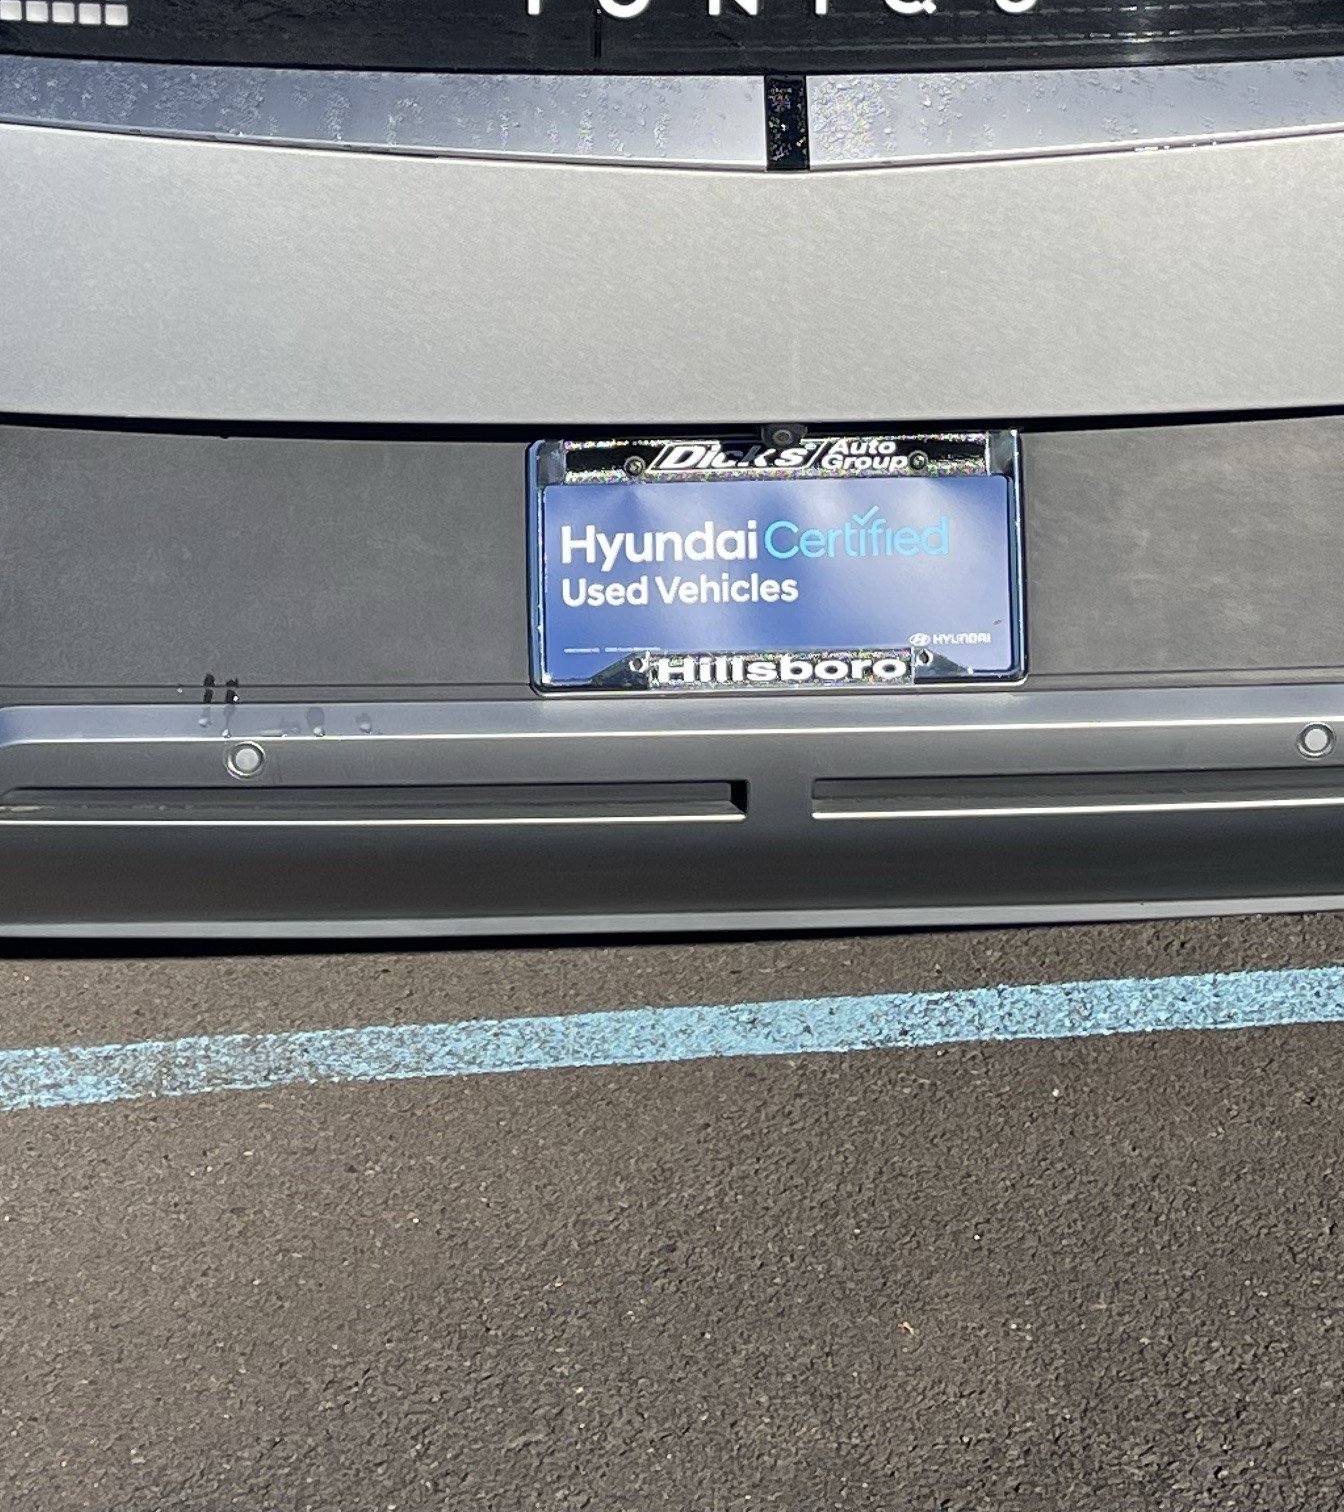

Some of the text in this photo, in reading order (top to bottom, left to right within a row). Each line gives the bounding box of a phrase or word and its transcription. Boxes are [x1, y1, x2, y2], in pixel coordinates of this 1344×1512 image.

[827, 439, 896, 456] Auto
[821, 453, 908, 471] Group
[561, 507, 949, 572] Hyundai Certified
[561, 573, 799, 607] Used Vehicles
[932, 632, 991, 645] HYUNDAI
[657, 655, 908, 684] Hillsboro
